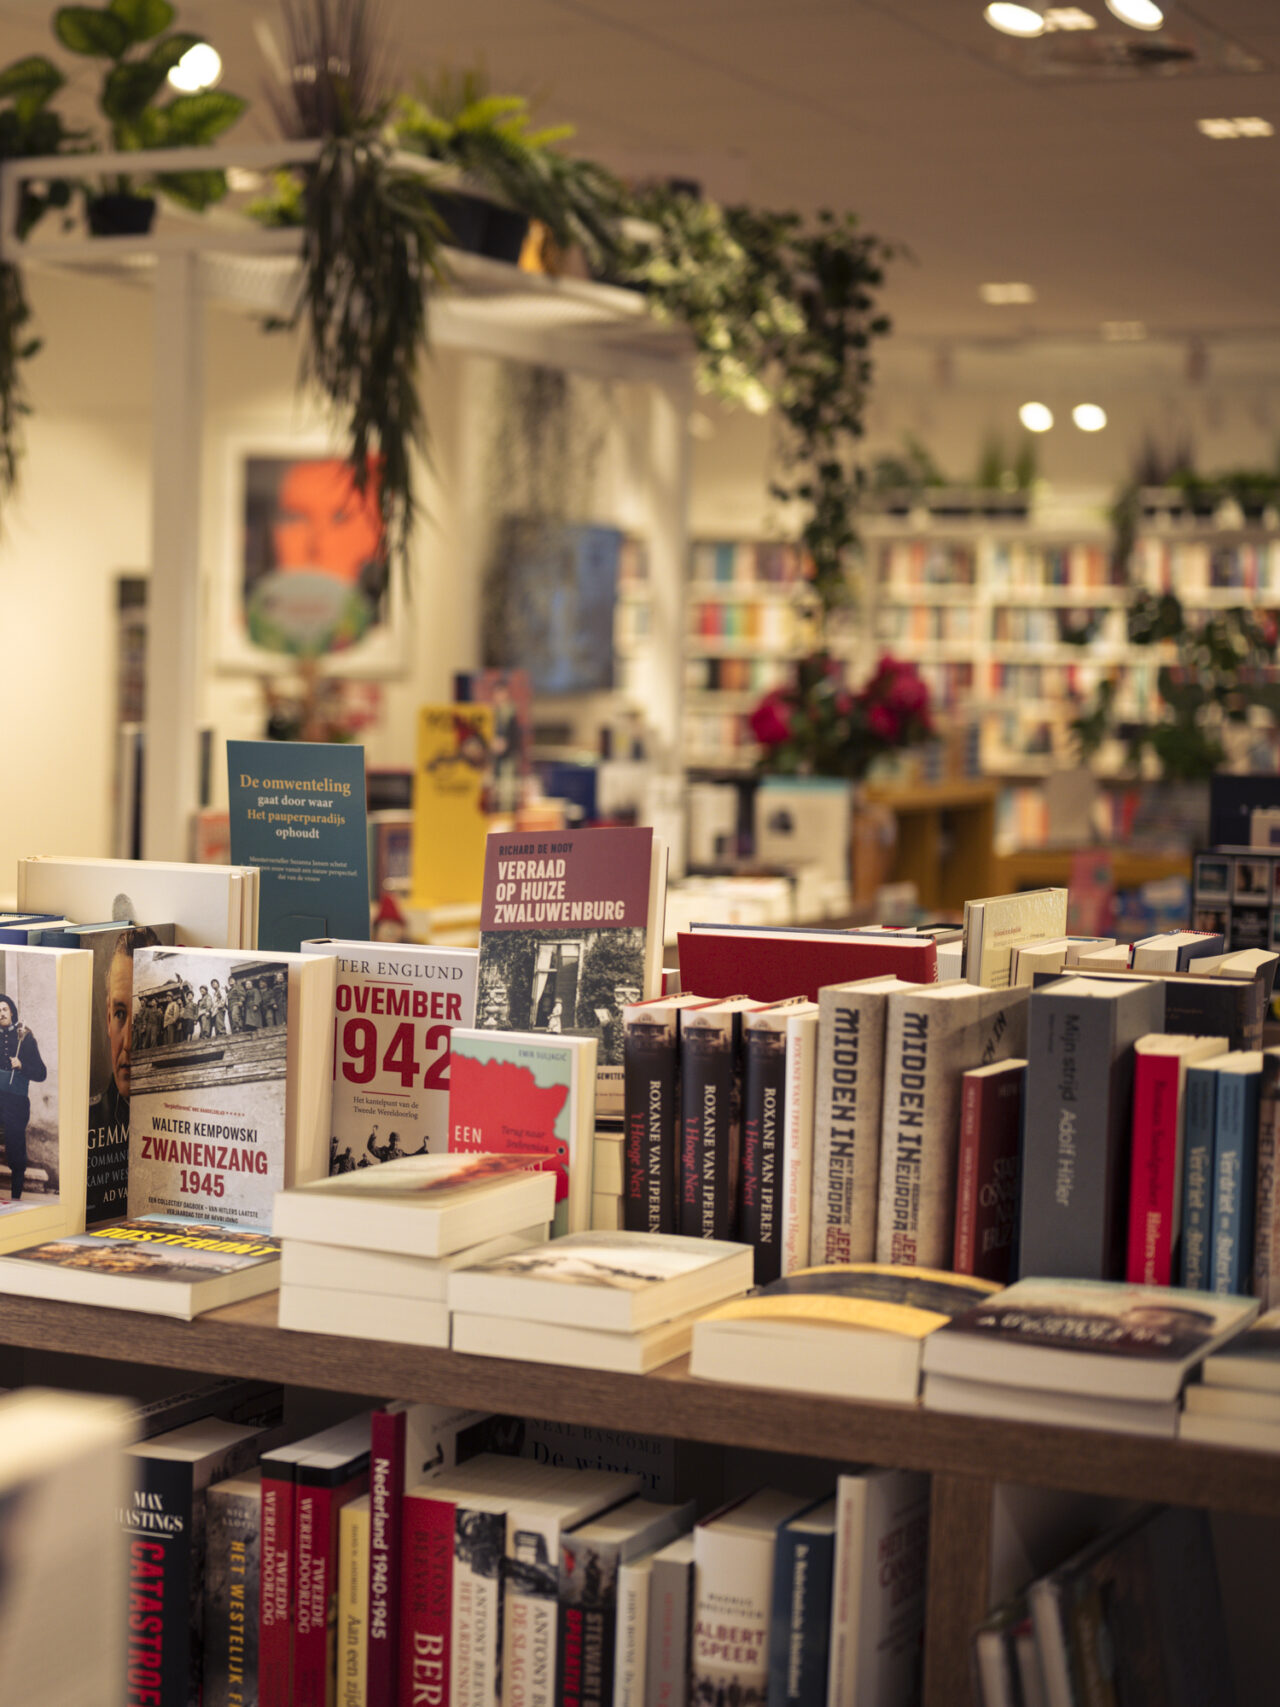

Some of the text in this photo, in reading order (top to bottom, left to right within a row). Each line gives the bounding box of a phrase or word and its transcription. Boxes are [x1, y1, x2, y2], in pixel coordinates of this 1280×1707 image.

[240, 774, 352, 797] De omwenteling
[257, 795, 333, 808] gaat door waar
[247, 809, 346, 827] Het pauperparadijs
[275, 827, 320, 840] ophoudt
[499, 842, 573, 856] RICHARD DE NOOY
[498, 859, 566, 880] VERRAAD
[496, 880, 566, 902] OP HUIZE
[494, 900, 625, 924] ZWALUWENBURG
[377, 962, 464, 981] ENGLUND
[791, 1037, 802, 1081] ROXANE
[791, 1085, 801, 1106] VAN
[829, 1008, 860, 1159] MIDDEN IN
[896, 1012, 929, 1164] MIDDEN IN
[353, 1096, 419, 1109] Het kantelpunt van de
[354, 1106, 418, 1120] Tweede Wereldoorlog
[1055, 1015, 1080, 1207] Mijn strijd Adolf Hitler
[151, 1116, 258, 1142] WALTER KEMPOWSKI
[454, 1125, 482, 1144] EEN
[627, 1123, 645, 1166] Hooge
[790, 1109, 801, 1149] IPEREN
[141, 1135, 268, 1175] ZWANENZANG
[648, 1080, 661, 1233] ROXANE VAN IPEREN
[682, 1127, 699, 1170] Hooge
[702, 1085, 716, 1239] ROXANE VAN IPEREN
[742, 1129, 758, 1172] Hooge
[759, 1088, 776, 1243] ROXANE VAN IPEREN
[103, 1189, 116, 1202] AD
[180, 1169, 225, 1198] 1945
[631, 1167, 643, 1199] Nest
[685, 1172, 698, 1203] Nest
[743, 1175, 757, 1206] Nest
[827, 1158, 844, 1225] EUROPA
[1187, 1146, 1208, 1209] Verdriet
[1219, 1151, 1238, 1214] Verdriet
[892, 1163, 911, 1231] EUROPA
[89, 1228, 280, 1257] OOSTFRONT
[1145, 1211, 1161, 1259] Hitlers
[533, 1441, 564, 1467] De
[134, 1491, 163, 1511] MAX
[229, 1540, 246, 1574] HET
[263, 1490, 276, 1627] WERELDOORLOG
[298, 1497, 313, 1635] WERELDOORLOG
[371, 1458, 389, 1640] Nederland 1940-1945
[275, 1549, 289, 1621] TWEEDE
[311, 1557, 325, 1628] TWEEDE
[460, 1581, 473, 1614] HET
[228, 1583, 245, 1684] WESTELIJK
[347, 1615, 362, 1646] Aan
[474, 1583, 487, 1656] ANTONY
[512, 1604, 528, 1630] DE
[695, 1621, 768, 1648] ALBERT
[346, 1648, 360, 1677] een
[510, 1633, 528, 1681] SLAG
[532, 1607, 549, 1690] ANTONY
[563, 1609, 583, 1694] OPERATIE
[584, 1611, 603, 1697] STEWART
[699, 1640, 759, 1665] SPEER
[413, 1631, 444, 1706] BER
